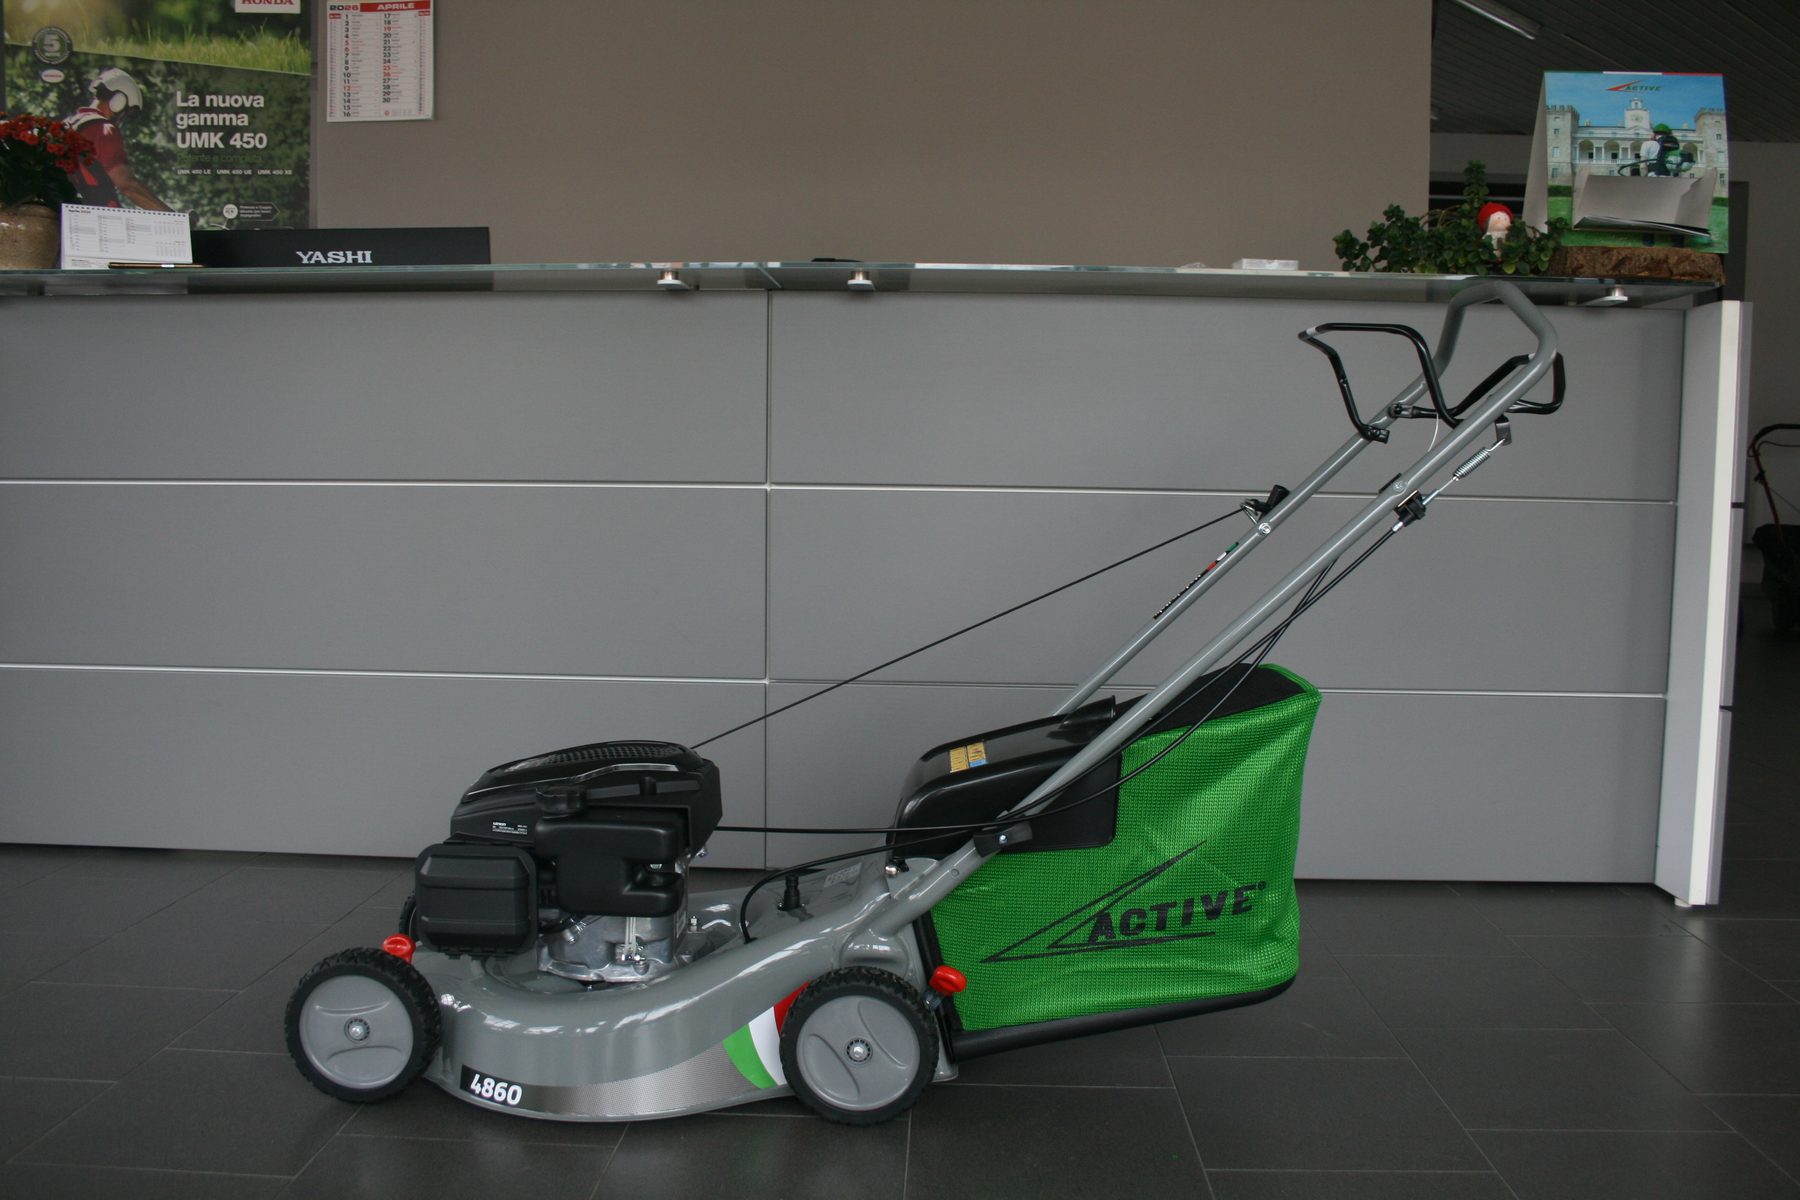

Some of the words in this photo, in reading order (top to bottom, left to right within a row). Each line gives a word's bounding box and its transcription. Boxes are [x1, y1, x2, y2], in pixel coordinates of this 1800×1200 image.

[376, 3, 415, 11] APRILE
[176, 91, 199, 107] La
[205, 94, 264, 108] nuova
[176, 113, 249, 129] gamma
[176, 132, 225, 148] UMK
[229, 132, 268, 149] 450
[296, 250, 373, 264] YASHI
[1088, 884, 1258, 945] ACTIVE
[470, 1073, 522, 1105] 4860
